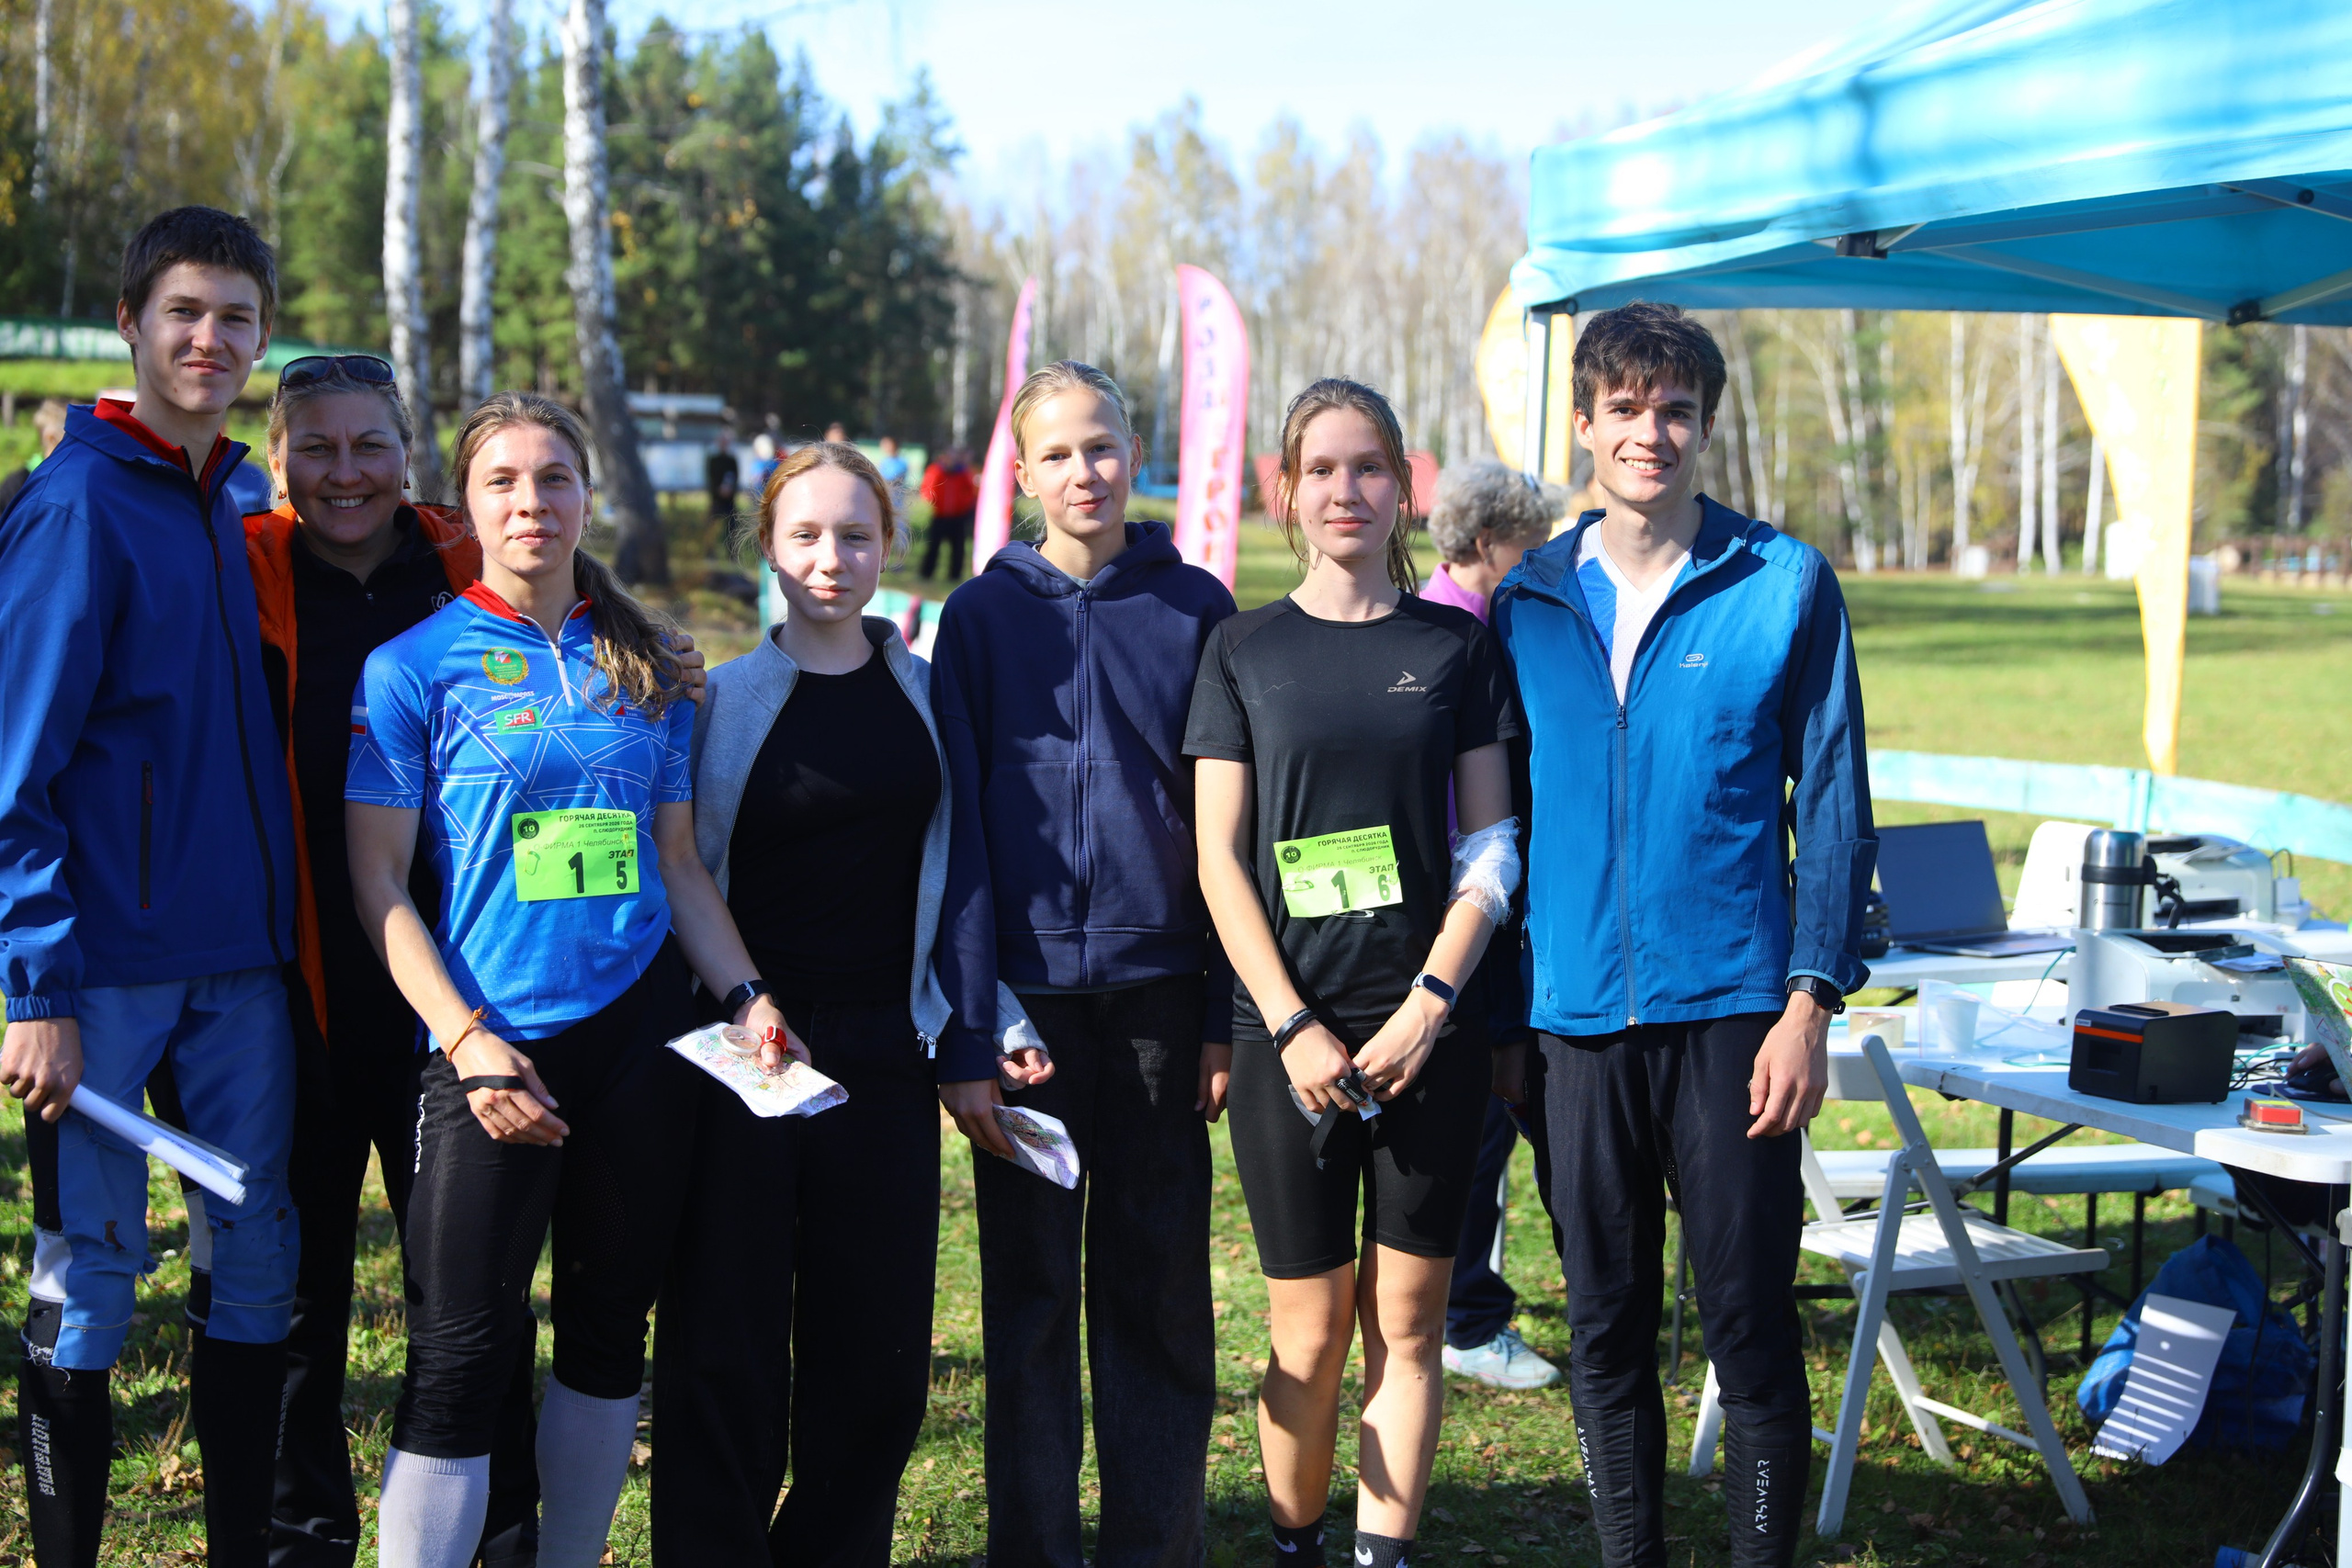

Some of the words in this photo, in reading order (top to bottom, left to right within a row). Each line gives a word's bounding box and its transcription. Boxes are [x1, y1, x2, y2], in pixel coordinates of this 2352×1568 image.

[503, 711, 533, 726] SFR
[559, 814, 595, 823] ГОРЯЧАЯ
[597, 812, 632, 821] ДЕСЯТКА
[583, 838, 624, 848] Челябинск
[1317, 836, 1352, 847] ГОРЯЧАЯ
[1352, 831, 1387, 843] ДЕСЯТКА
[608, 849, 635, 860] ЭТАП
[1342, 855, 1383, 866] Челябинск
[568, 852, 584, 894] 1
[616, 861, 628, 890] 5
[1369, 863, 1394, 874] ЭТАП
[1330, 870, 1350, 908] 1
[1378, 874, 1391, 902] 6
[31, 1413, 56, 1496] noname
[1755, 1459, 1770, 1533] ARSWEAR
